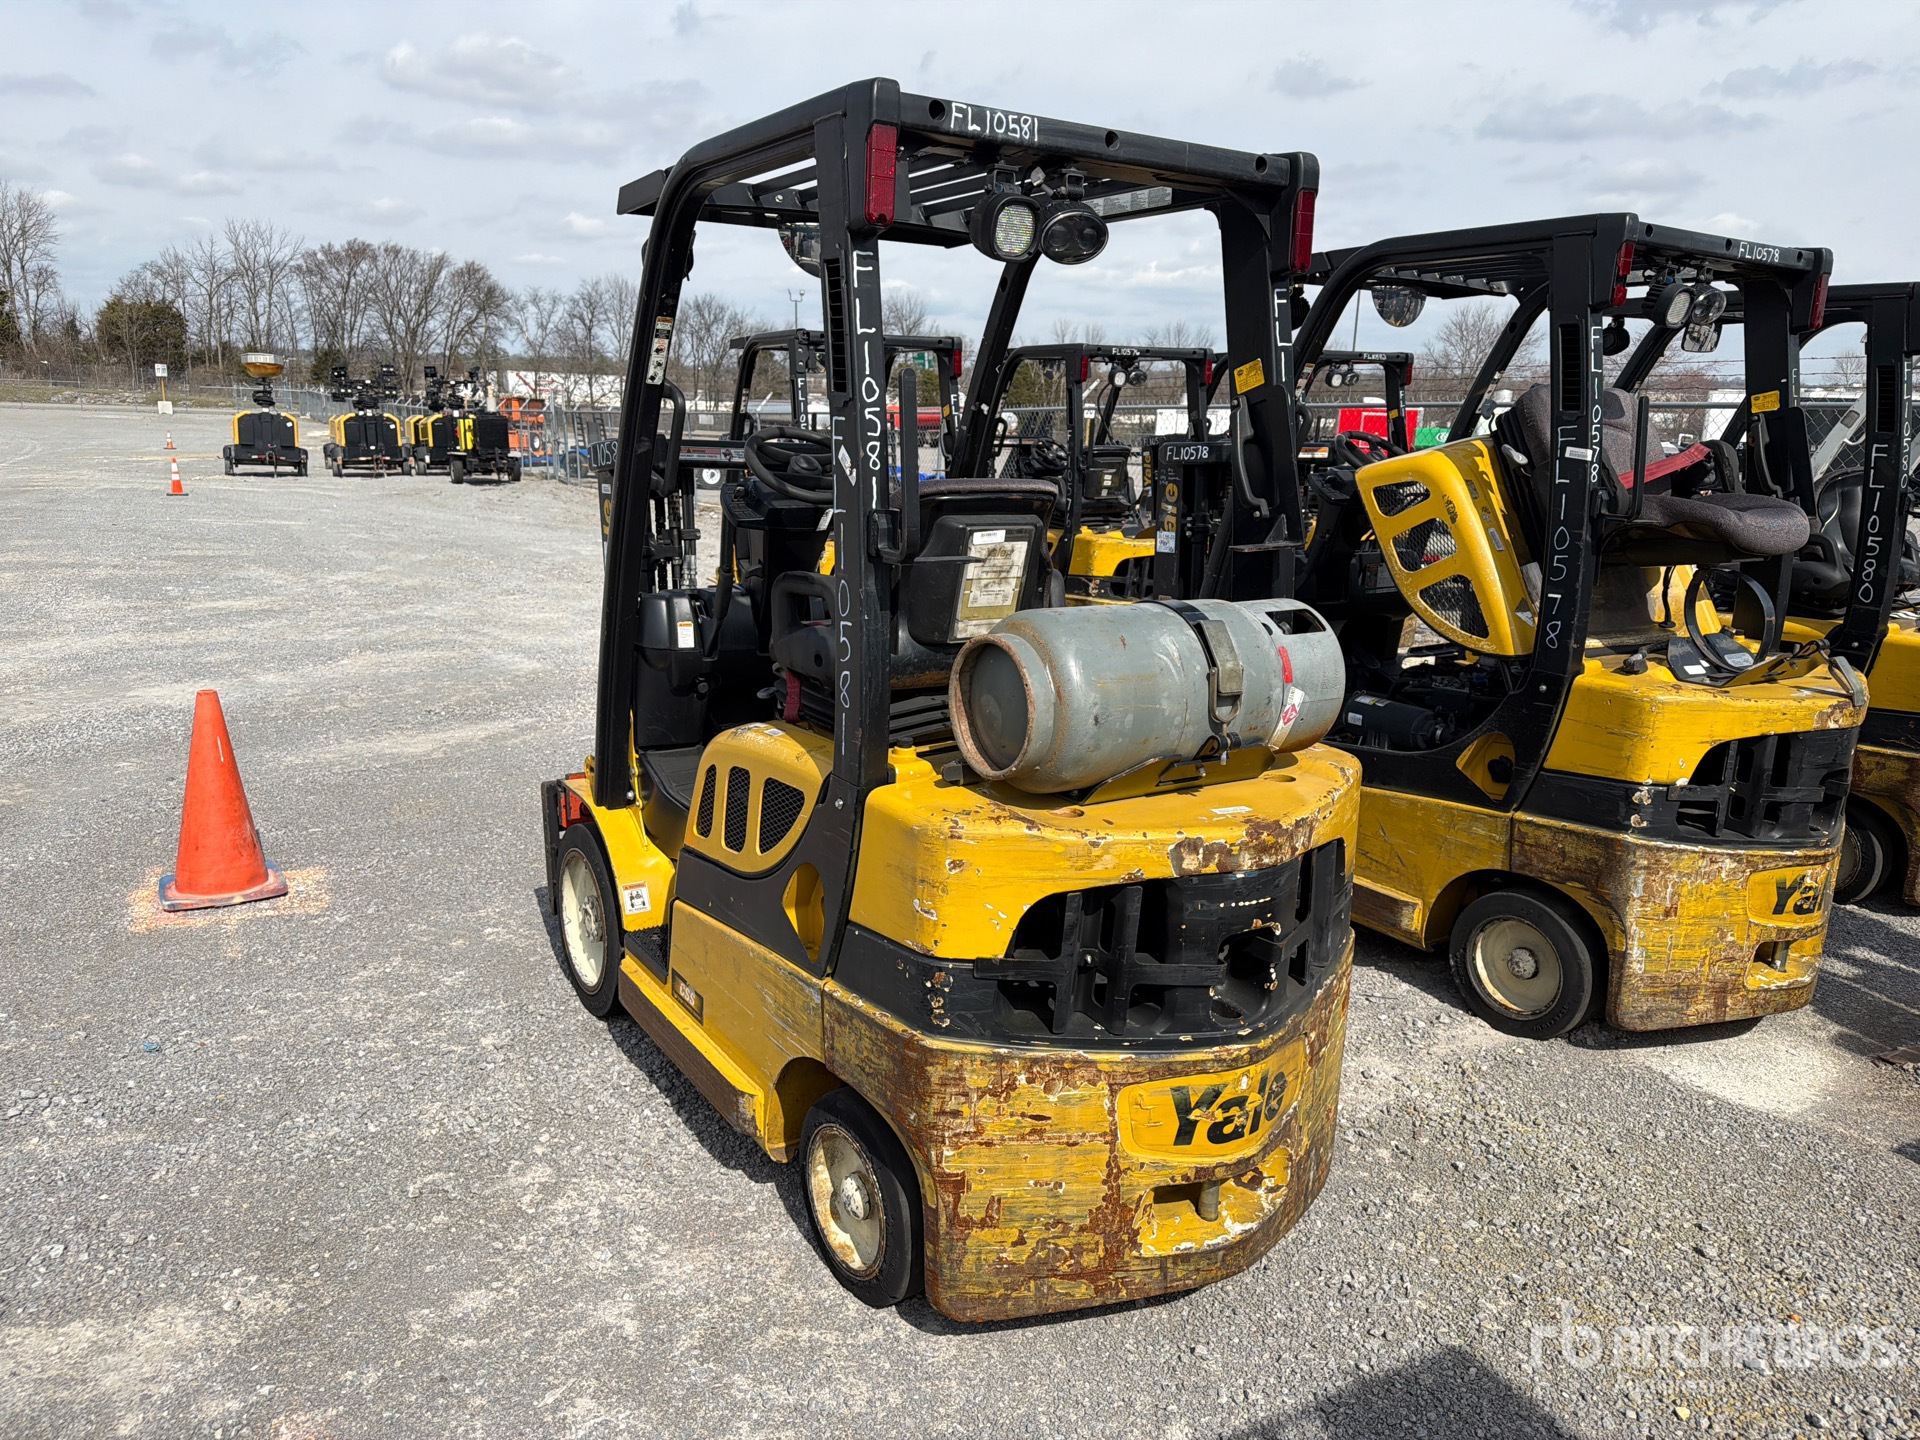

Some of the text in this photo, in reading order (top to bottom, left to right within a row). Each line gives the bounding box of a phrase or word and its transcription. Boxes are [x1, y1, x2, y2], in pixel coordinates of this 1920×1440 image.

[950, 102, 1038, 141] FL10581
[1737, 242, 1780, 262] FL10578
[853, 250, 881, 509] FL10581
[1274, 288, 1292, 382] FL1
[1590, 326, 1602, 483] FL10578
[1900, 361, 1912, 489] FL10580
[588, 440, 618, 467] L1058
[1166, 445, 1210, 461] FL10578
[1160, 482, 1178, 532] ale
[1546, 425, 1578, 648] FL10578
[1858, 444, 1888, 603] FL10580
[832, 416, 851, 755] FL10581
[1170, 1070, 1288, 1146] Yale
